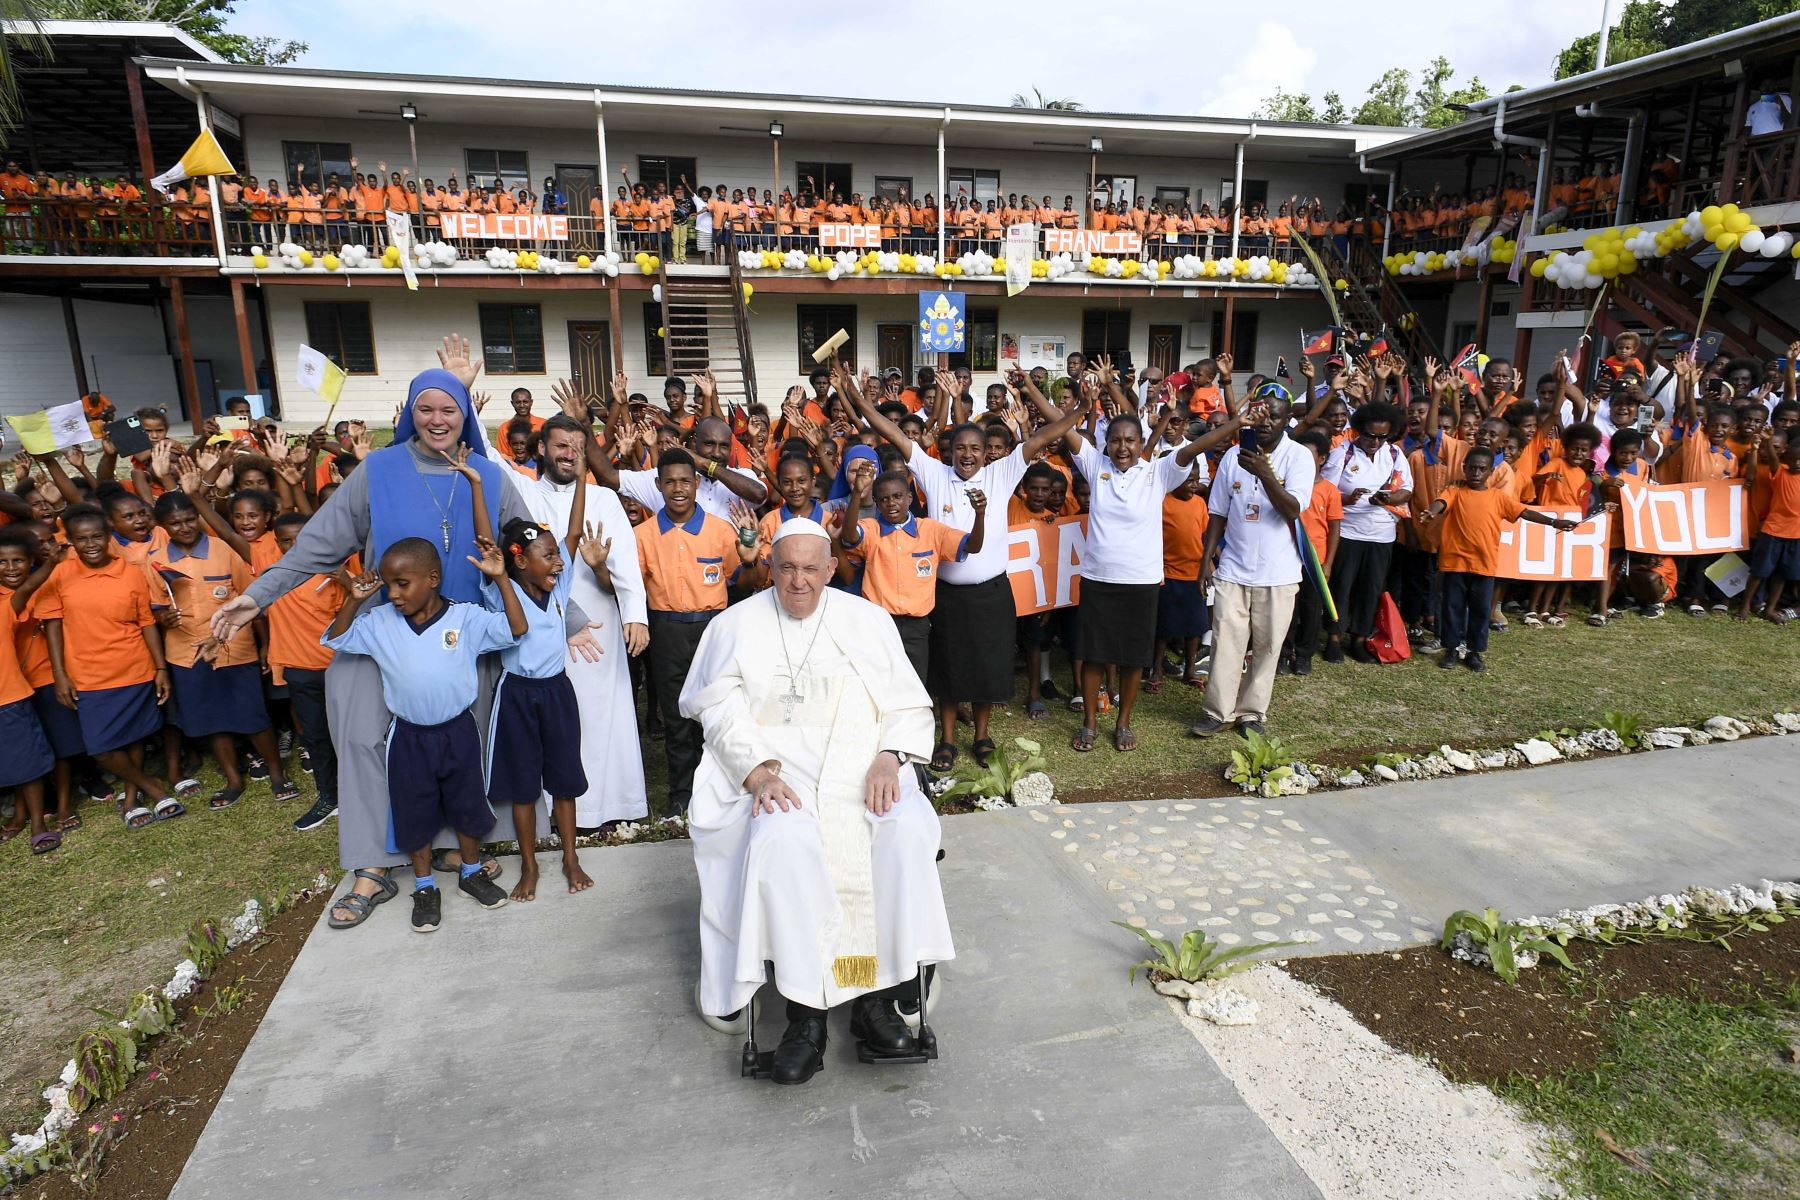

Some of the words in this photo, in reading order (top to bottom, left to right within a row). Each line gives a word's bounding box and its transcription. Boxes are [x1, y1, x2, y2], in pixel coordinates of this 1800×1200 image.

[441, 214, 568, 240] WELCOME
[821, 224, 881, 247] POPE
[1045, 229, 1140, 253] FRANCIS
[1621, 483, 1744, 551] YOU
[1500, 511, 1607, 578] OR
